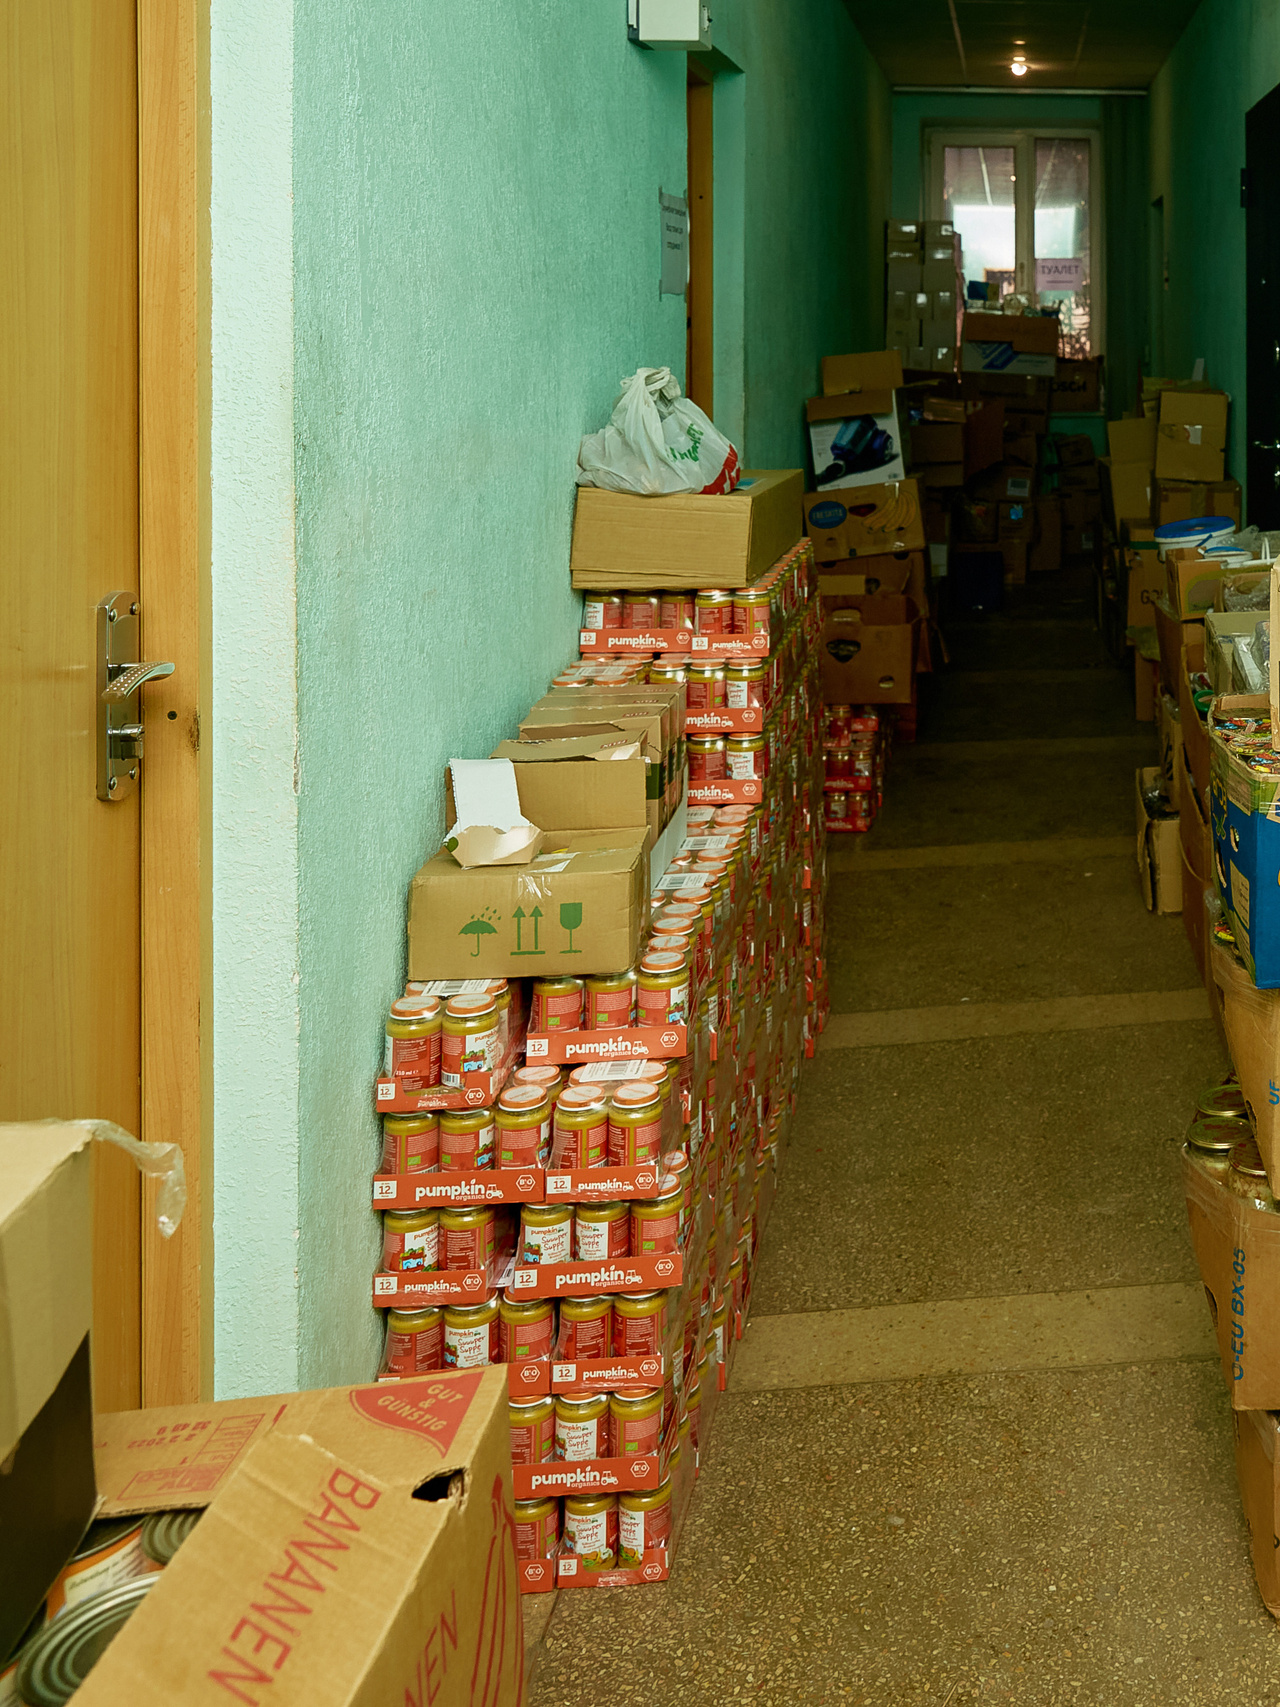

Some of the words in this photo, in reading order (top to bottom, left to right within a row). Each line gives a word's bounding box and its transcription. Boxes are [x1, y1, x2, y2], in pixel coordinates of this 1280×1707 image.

[1041, 264, 1079, 275] ТУАЛЕТ
[608, 633, 656, 649] pumpkin
[712, 639, 744, 650] pumpkin
[686, 712, 721, 728] mpkin
[687, 785, 721, 800] mpkin
[565, 1036, 631, 1058] pumpkin
[415, 1179, 486, 1201] pumpkin
[578, 1178, 623, 1192] pumpkin
[556, 1265, 624, 1289] pumpkin
[1231, 1246, 1246, 1316] BX-05
[404, 1279, 450, 1293] pumpkin
[583, 1366, 628, 1380] pumpkin
[427, 1383, 464, 1404] GUT
[418, 1397, 436, 1409] &
[377, 1394, 448, 1432] GÜNSTIG
[531, 1466, 600, 1490] pumpkin
[207, 1467, 382, 1707] BANANEN
